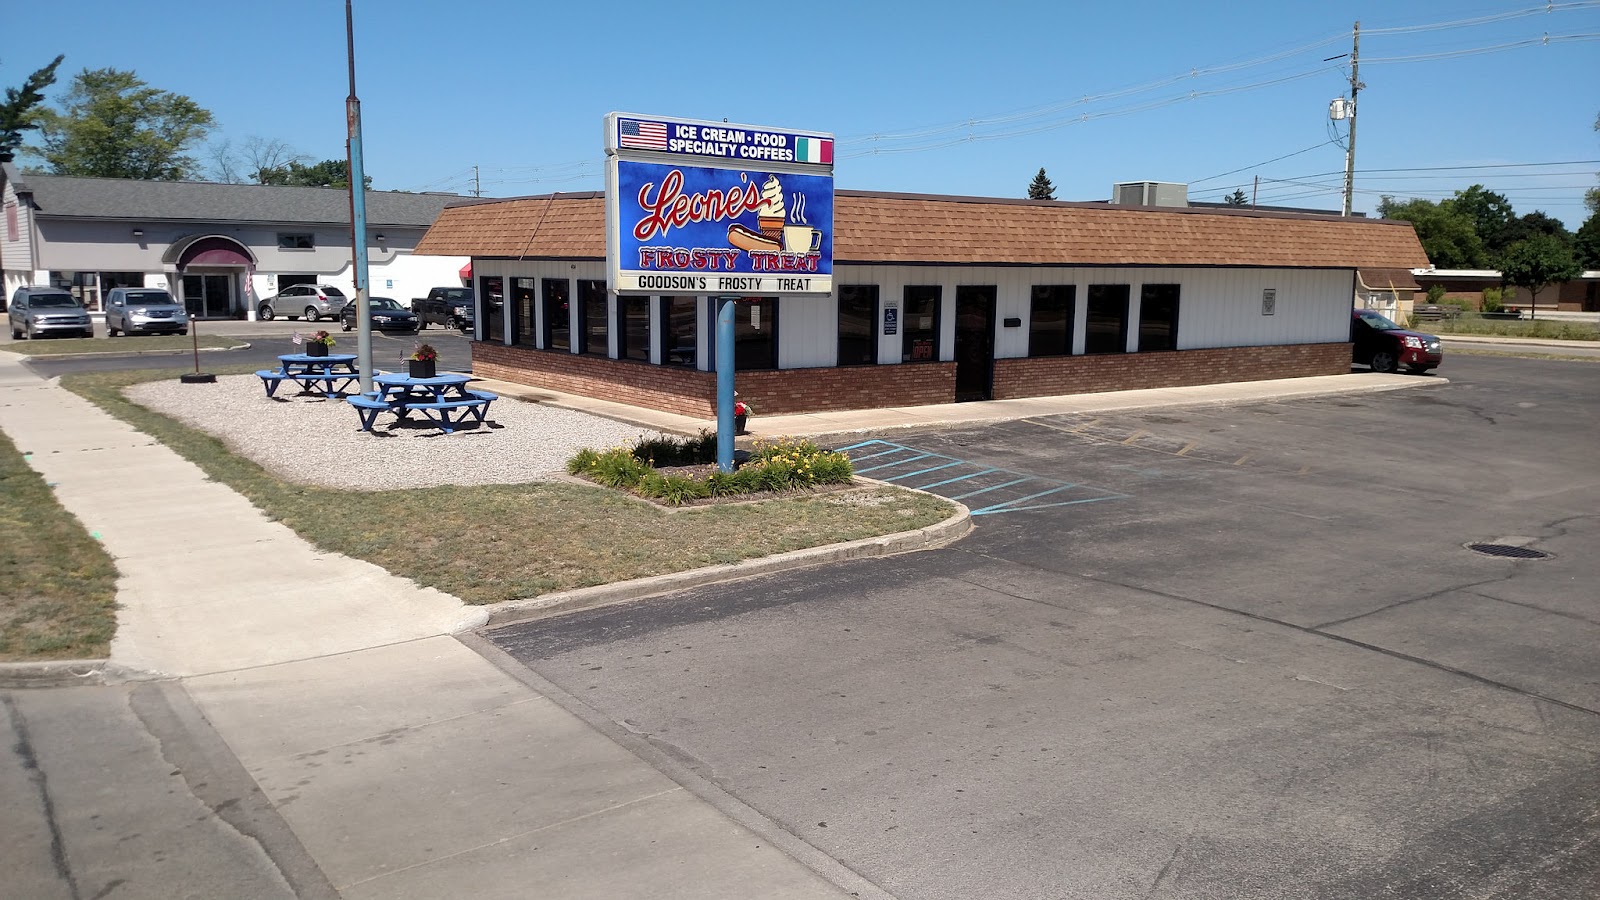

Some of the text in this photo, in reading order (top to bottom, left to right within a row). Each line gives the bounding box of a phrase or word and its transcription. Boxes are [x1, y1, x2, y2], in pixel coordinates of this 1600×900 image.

[675, 125, 786, 147] ICE CREAM FOOD
[669, 138, 793, 161] SPECIALTY COFFEES
[633, 169, 771, 241] Leone's
[638, 246, 821, 271] FROSTY TREAT
[638, 275, 811, 291] GOODSON'S FROSTY TREAT
